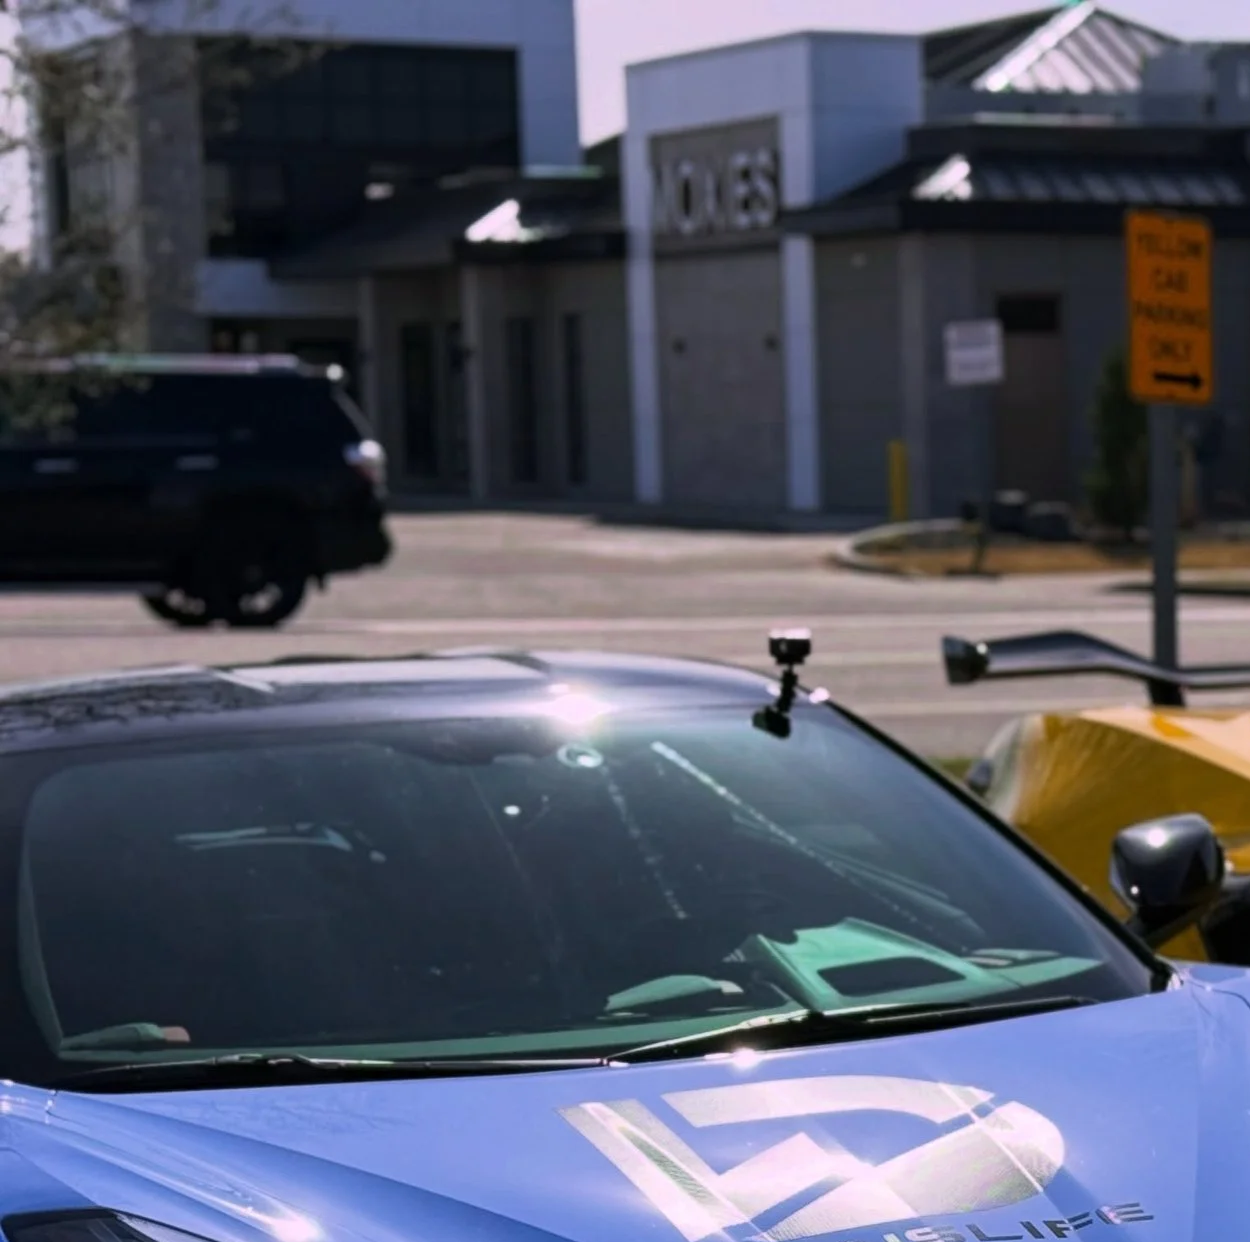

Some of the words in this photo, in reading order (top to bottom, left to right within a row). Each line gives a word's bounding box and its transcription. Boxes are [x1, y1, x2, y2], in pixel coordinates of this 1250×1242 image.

[1137, 231, 1204, 259] YELLOW
[1133, 299, 1207, 330] PARKING
[1148, 335, 1192, 363] ONLY
